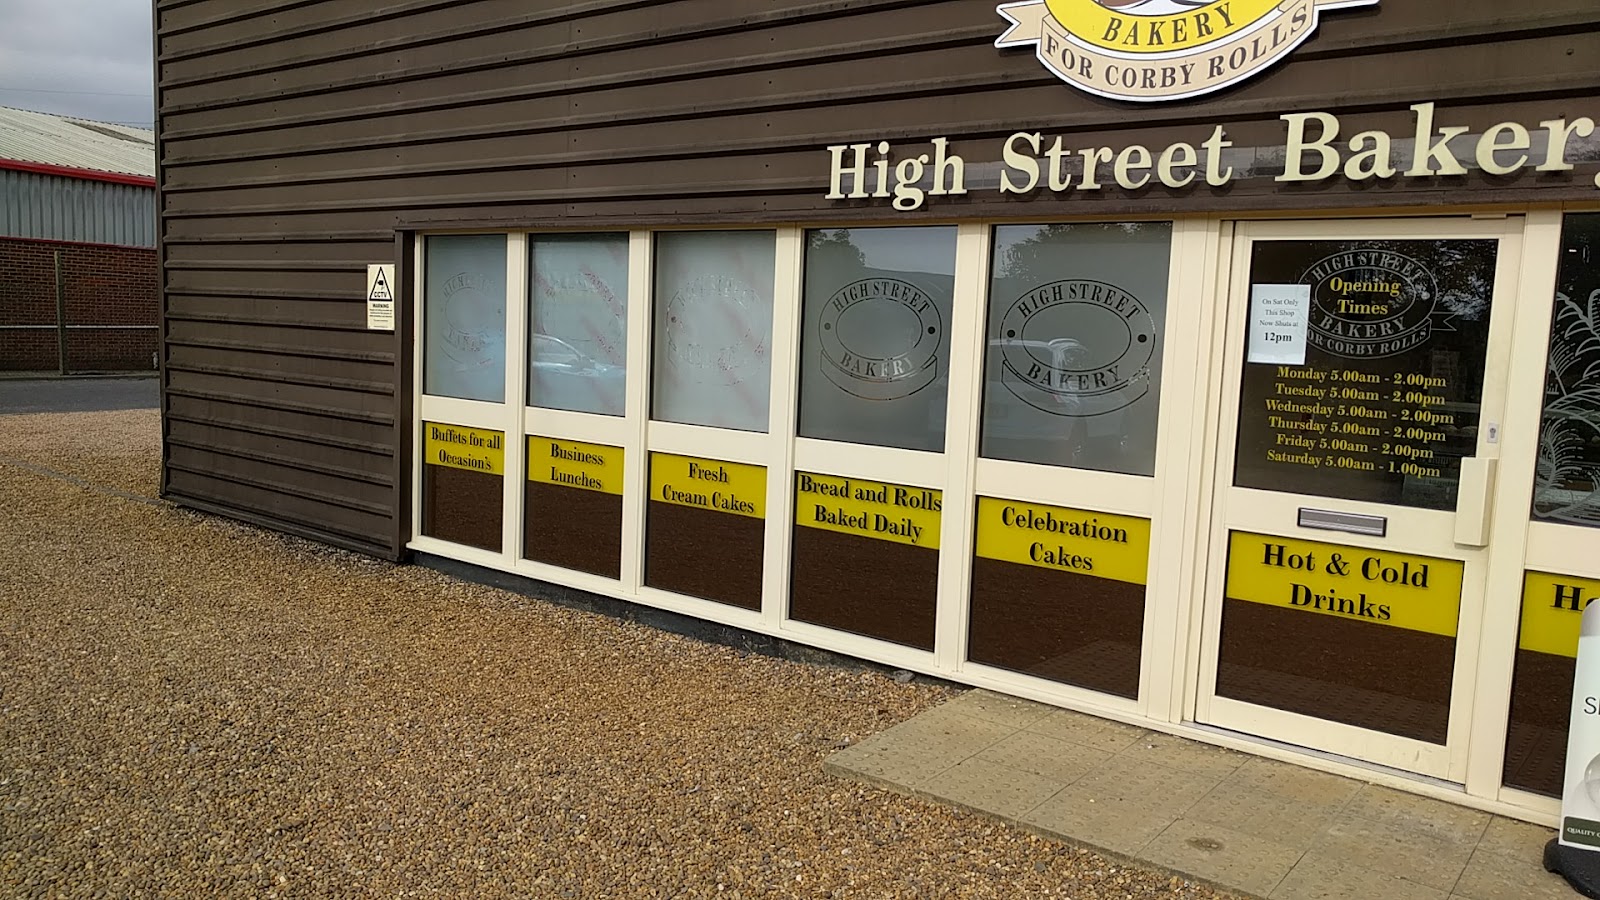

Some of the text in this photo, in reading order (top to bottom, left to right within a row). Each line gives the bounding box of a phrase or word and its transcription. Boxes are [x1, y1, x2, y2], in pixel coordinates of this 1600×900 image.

[1101, 2, 1235, 46] BAKERY
[1046, 3, 1309, 90] FOR CORBY ROLLS
[824, 101, 1600, 211] High Street Baker
[1311, 252, 1425, 281] HIGH STREET
[832, 281, 930, 314] HIGH STREET
[1330, 276, 1401, 297] Opening
[1017, 283, 1140, 320] HIGH STREET
[1337, 299, 1389, 315] Times
[1265, 332, 1292, 344] 12pm
[1319, 316, 1407, 338] BAKERY
[1307, 327, 1427, 355] OR CORBY ROLLS
[840, 353, 914, 377] BAKERY
[1026, 362, 1121, 390] BAKERY
[1277, 366, 1327, 382] Monday
[1330, 370, 1380, 384] 5.00am
[1393, 373, 1446, 389] 2.00pm
[1275, 383, 1326, 398] Tuesday
[1329, 387, 1379, 400] 5.00am
[1392, 391, 1445, 407] 2.00pm
[1265, 399, 1334, 418] Wednesday
[1337, 405, 1387, 419] 5.00am
[1401, 409, 1454, 426] 2.00pm
[431, 427, 501, 449] Buffets for all
[1269, 416, 1327, 434] Thursday
[1330, 422, 1380, 436] 5.00am
[1393, 426, 1446, 443] 2.00pm
[551, 443, 604, 466] Business
[1276, 433, 1316, 450] Friday
[1319, 438, 1368, 453] 5.00am
[1381, 443, 1434, 459] 2.00pm
[439, 449, 492, 471] Occasion's
[688, 462, 728, 482] Fresh
[1267, 449, 1322, 468] Saturday
[1325, 455, 1374, 471] 5.00am
[1388, 460, 1441, 478] 1.00pm
[551, 466, 602, 489] Lunches
[662, 484, 754, 513] Cream Cakes
[800, 474, 942, 512] Bread and Rolls
[814, 504, 922, 543] Baked Daily
[1002, 506, 1127, 543] Celebration
[1030, 542, 1093, 570] Cakes
[1261, 543, 1429, 588] Hot & Cold
[1288, 582, 1391, 621] Drinks
[1567, 827, 1595, 836] QUALITY
